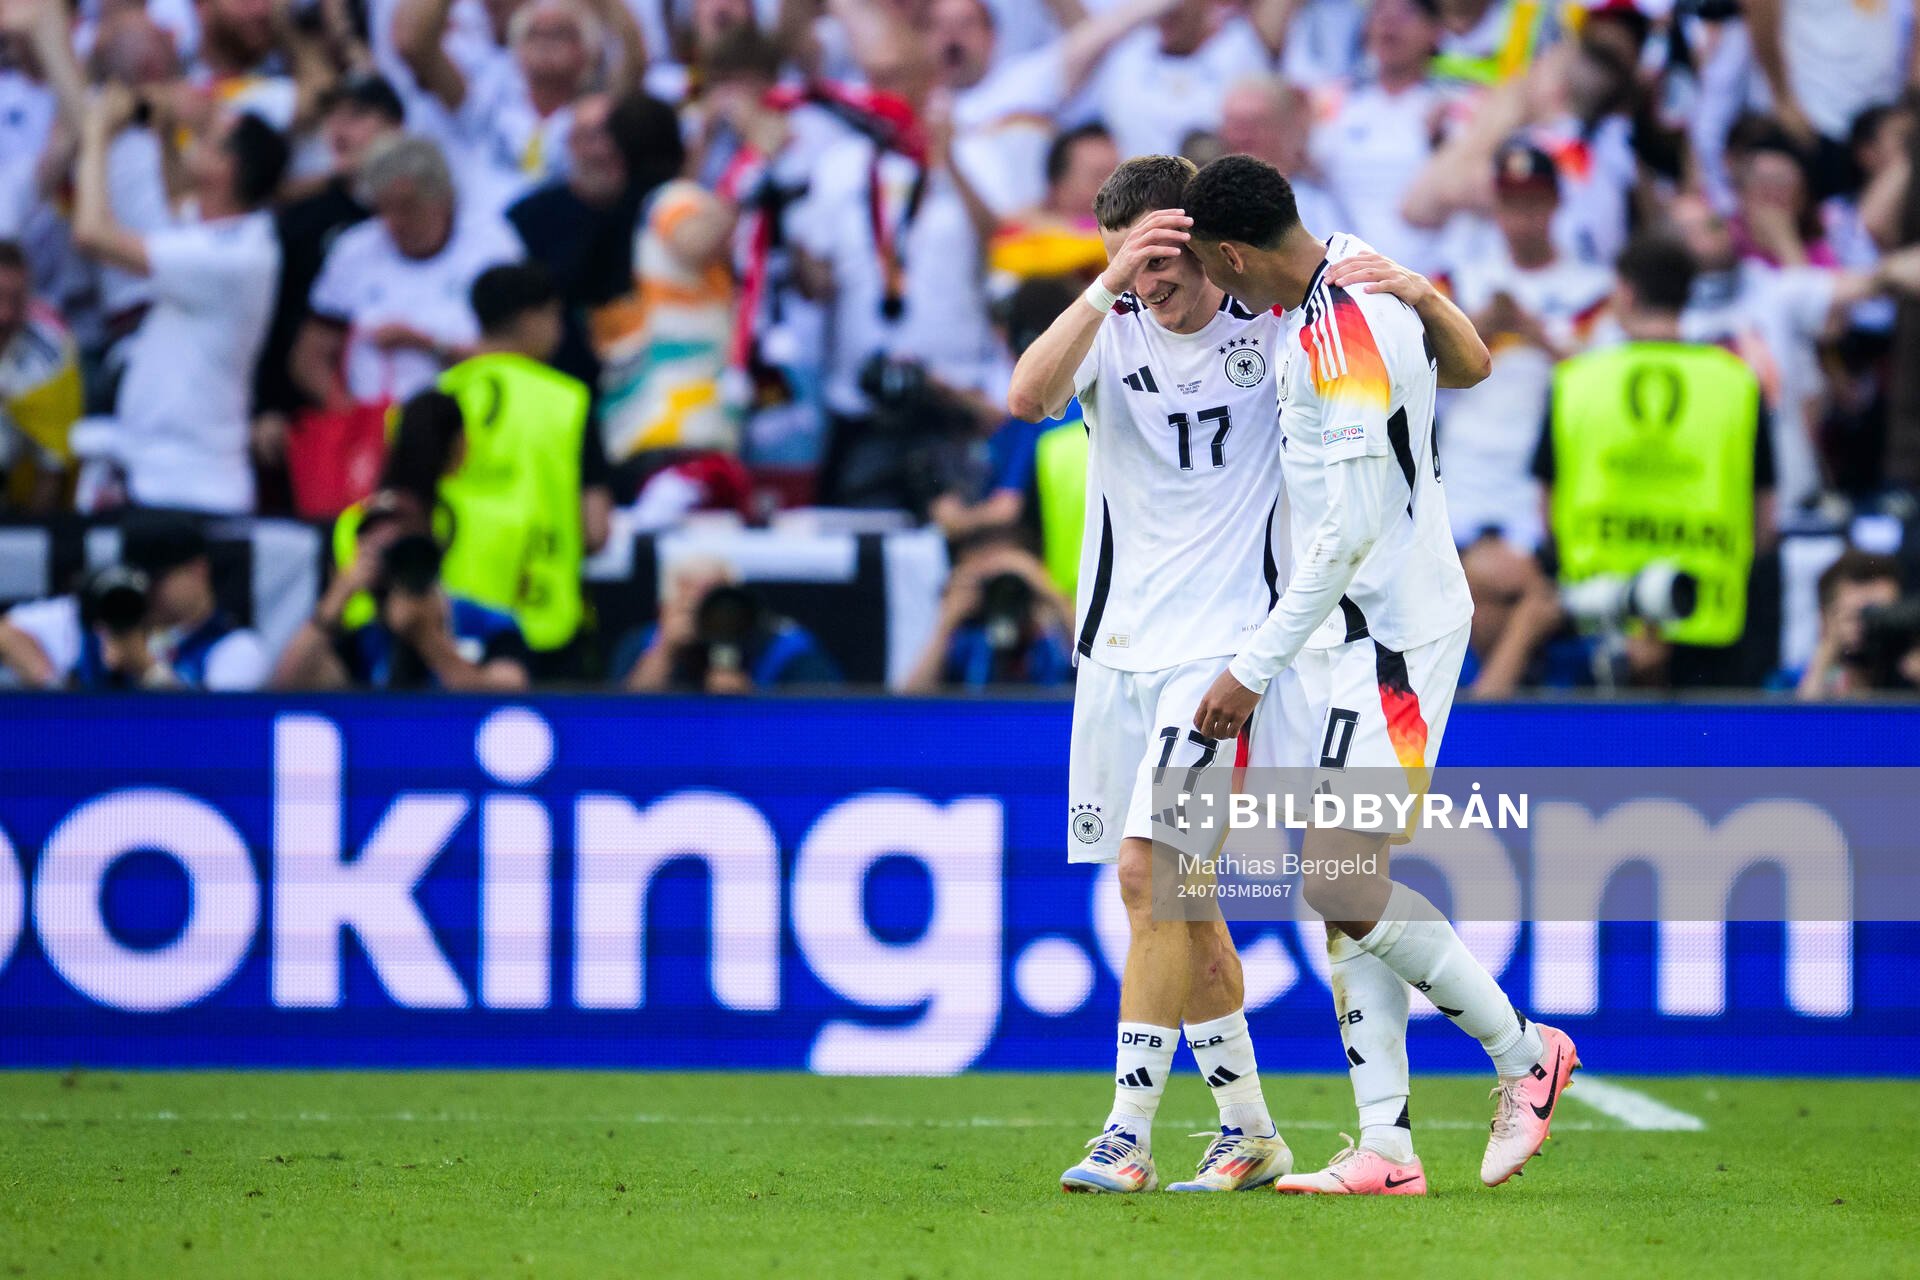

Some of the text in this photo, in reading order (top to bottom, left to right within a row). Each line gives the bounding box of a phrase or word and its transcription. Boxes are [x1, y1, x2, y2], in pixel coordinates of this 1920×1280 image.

[1167, 405, 1233, 471] 17
[1153, 726, 1220, 796] 17
[1320, 707, 1361, 773] 0
[0, 706, 1854, 1078] oking.om
[1121, 1031, 1163, 1048] DFB
[1339, 1009, 1364, 1026] FB
